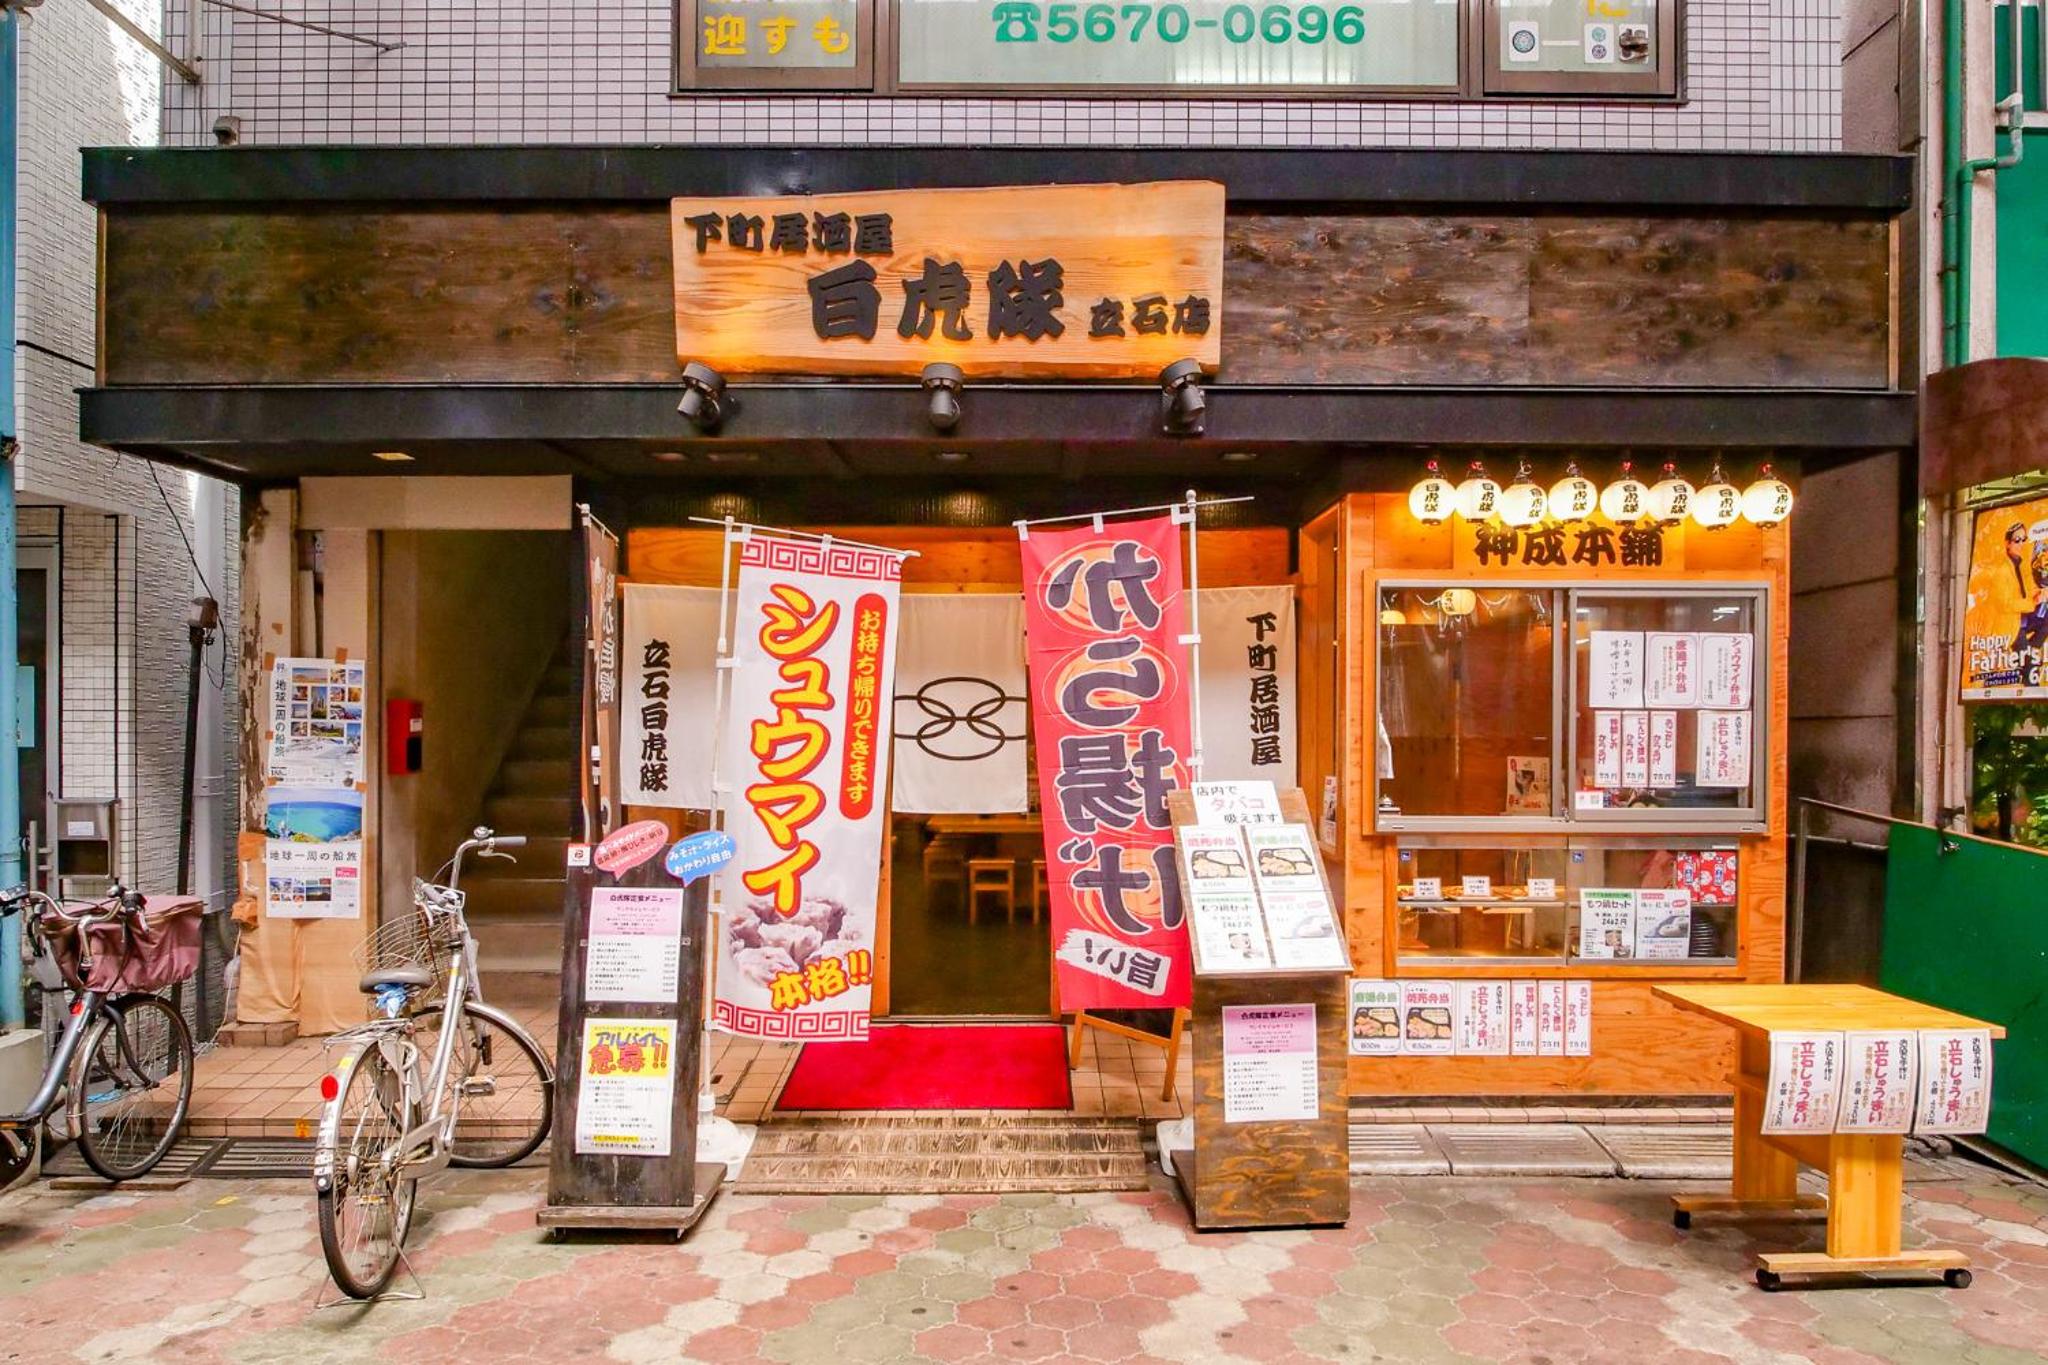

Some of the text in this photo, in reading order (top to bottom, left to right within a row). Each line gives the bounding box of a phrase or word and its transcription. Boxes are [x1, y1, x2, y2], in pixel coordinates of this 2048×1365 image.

[1046, 4, 1365, 44] 5670-0696
[684, 211, 894, 255] 下町居酒屋
[808, 257, 1066, 342] 白虎隊
[1088, 295, 1210, 338] 立石店
[1970, 635, 2011, 652] Happy
[1970, 645, 2041, 672] Father's
[846, 608, 881, 805] お持ち帰りできます
[1246, 612, 1283, 767] 下町居酒屋
[275, 680, 286, 757] 地球一周の船旅
[640, 639, 671, 793] 立石白虎隊
[742, 582, 841, 920] シュウマイ
[270, 851, 358, 861] 地球一周の船旅
[596, 1031, 664, 1048] アルバイト
